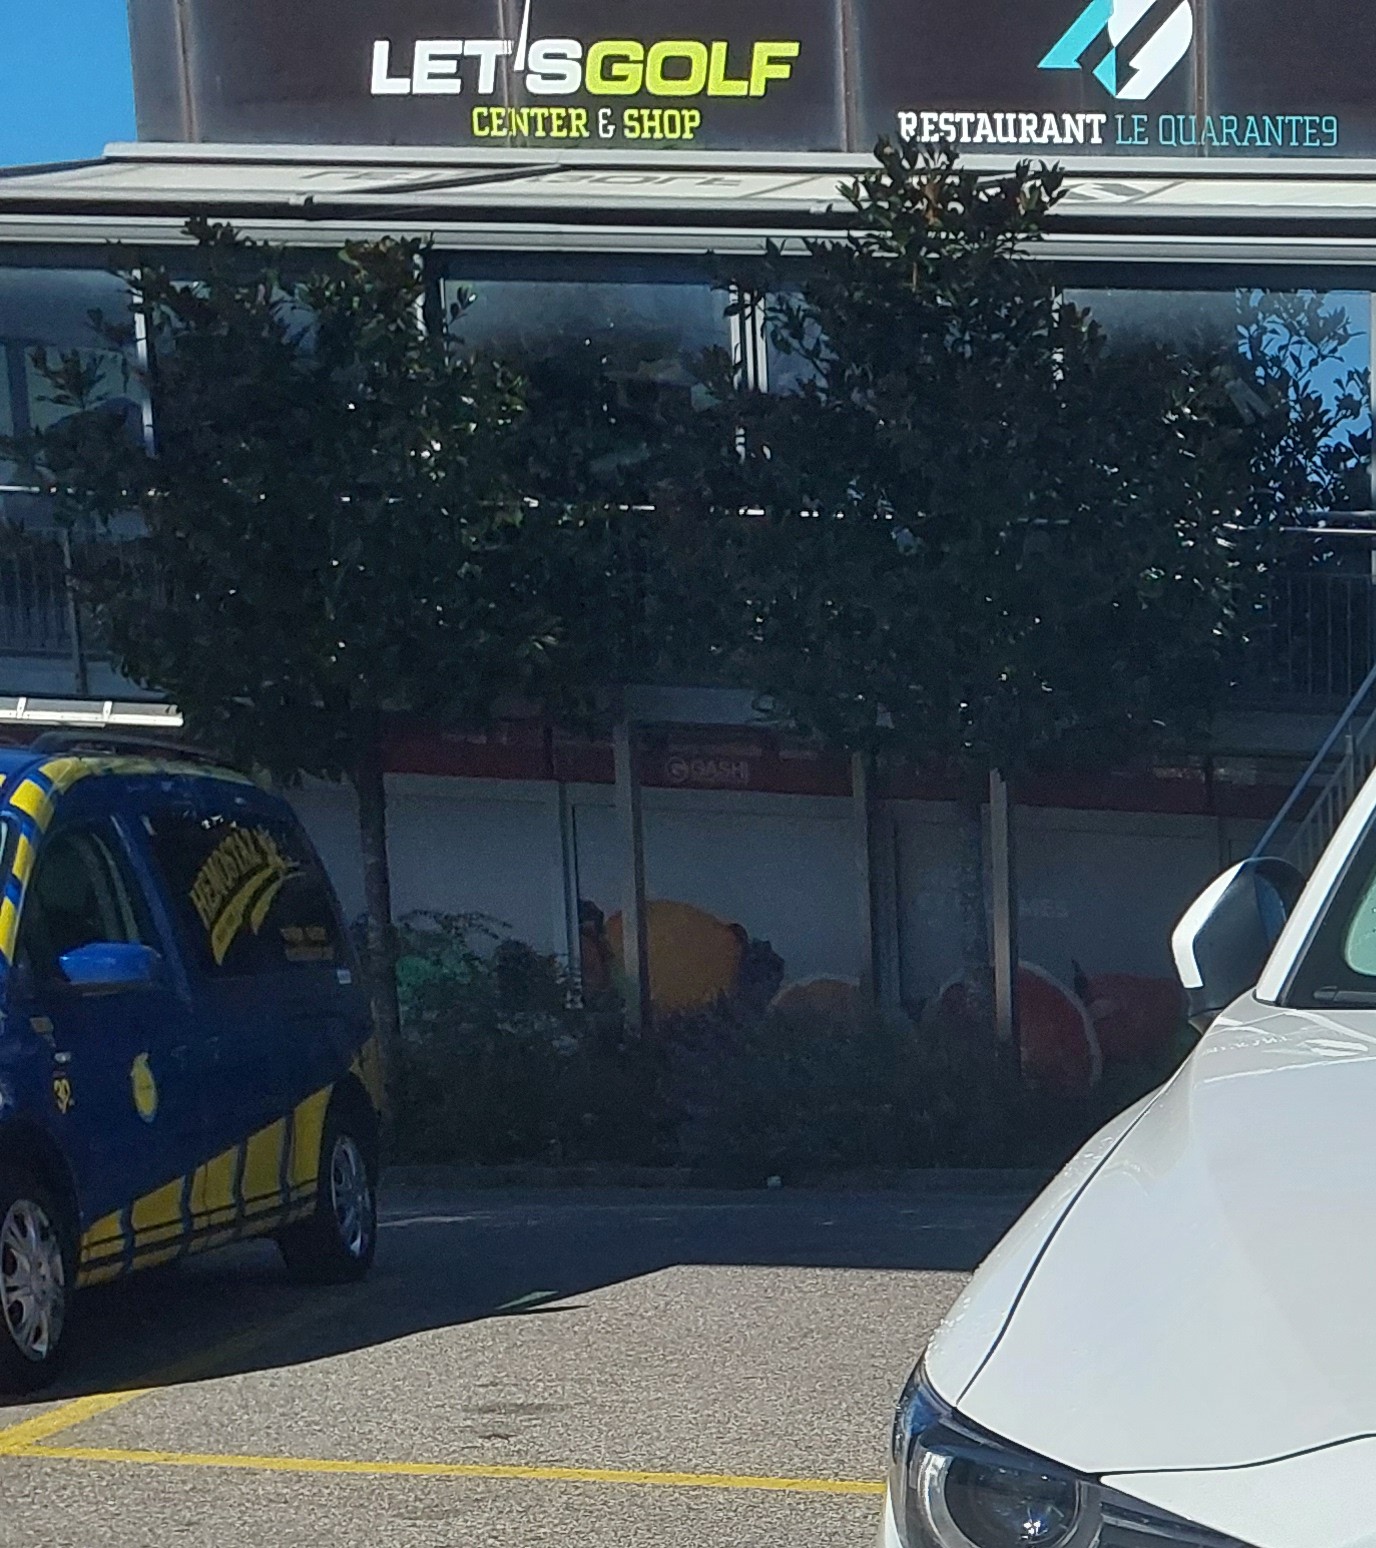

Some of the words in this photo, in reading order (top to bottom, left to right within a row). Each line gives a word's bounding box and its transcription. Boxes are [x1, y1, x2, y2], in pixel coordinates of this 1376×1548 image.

[471, 106, 590, 138] CENTER
[599, 109, 615, 138] &
[624, 108, 700, 139] SHOP
[898, 111, 1106, 144] RESTAURANT
[1115, 114, 1148, 144] LE
[1158, 114, 1337, 147] QUARANTE9
